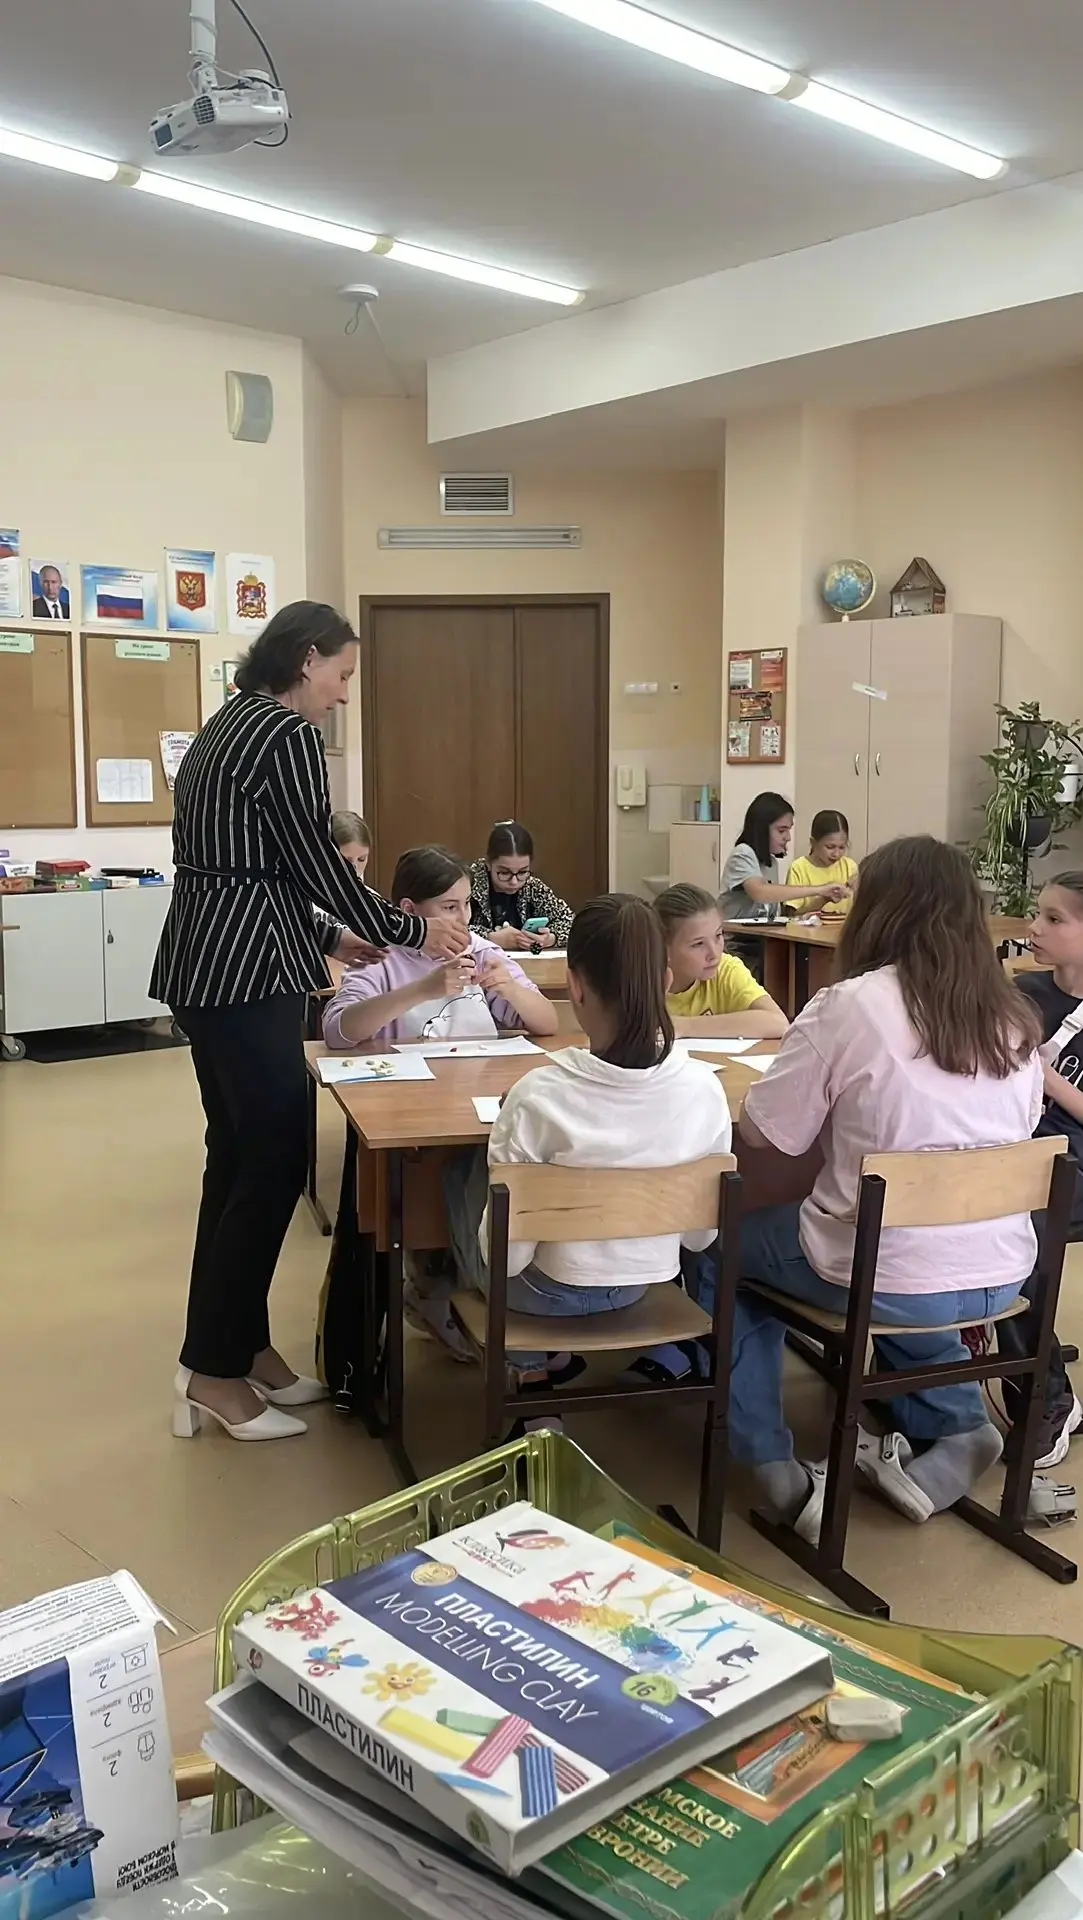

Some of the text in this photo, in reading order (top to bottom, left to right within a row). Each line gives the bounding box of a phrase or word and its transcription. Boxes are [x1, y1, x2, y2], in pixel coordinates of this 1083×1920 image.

[434, 1592, 600, 1690] ПЛАСТИЛИН
[375, 1591, 599, 1724] MODELLING CLAY
[99, 1674, 108, 1689] 2
[630, 1681, 656, 1697] 16
[102, 1712, 112, 1728] 2
[297, 1682, 415, 1792] ПЛАСТИЛИН
[108, 1760, 118, 1777] 2
